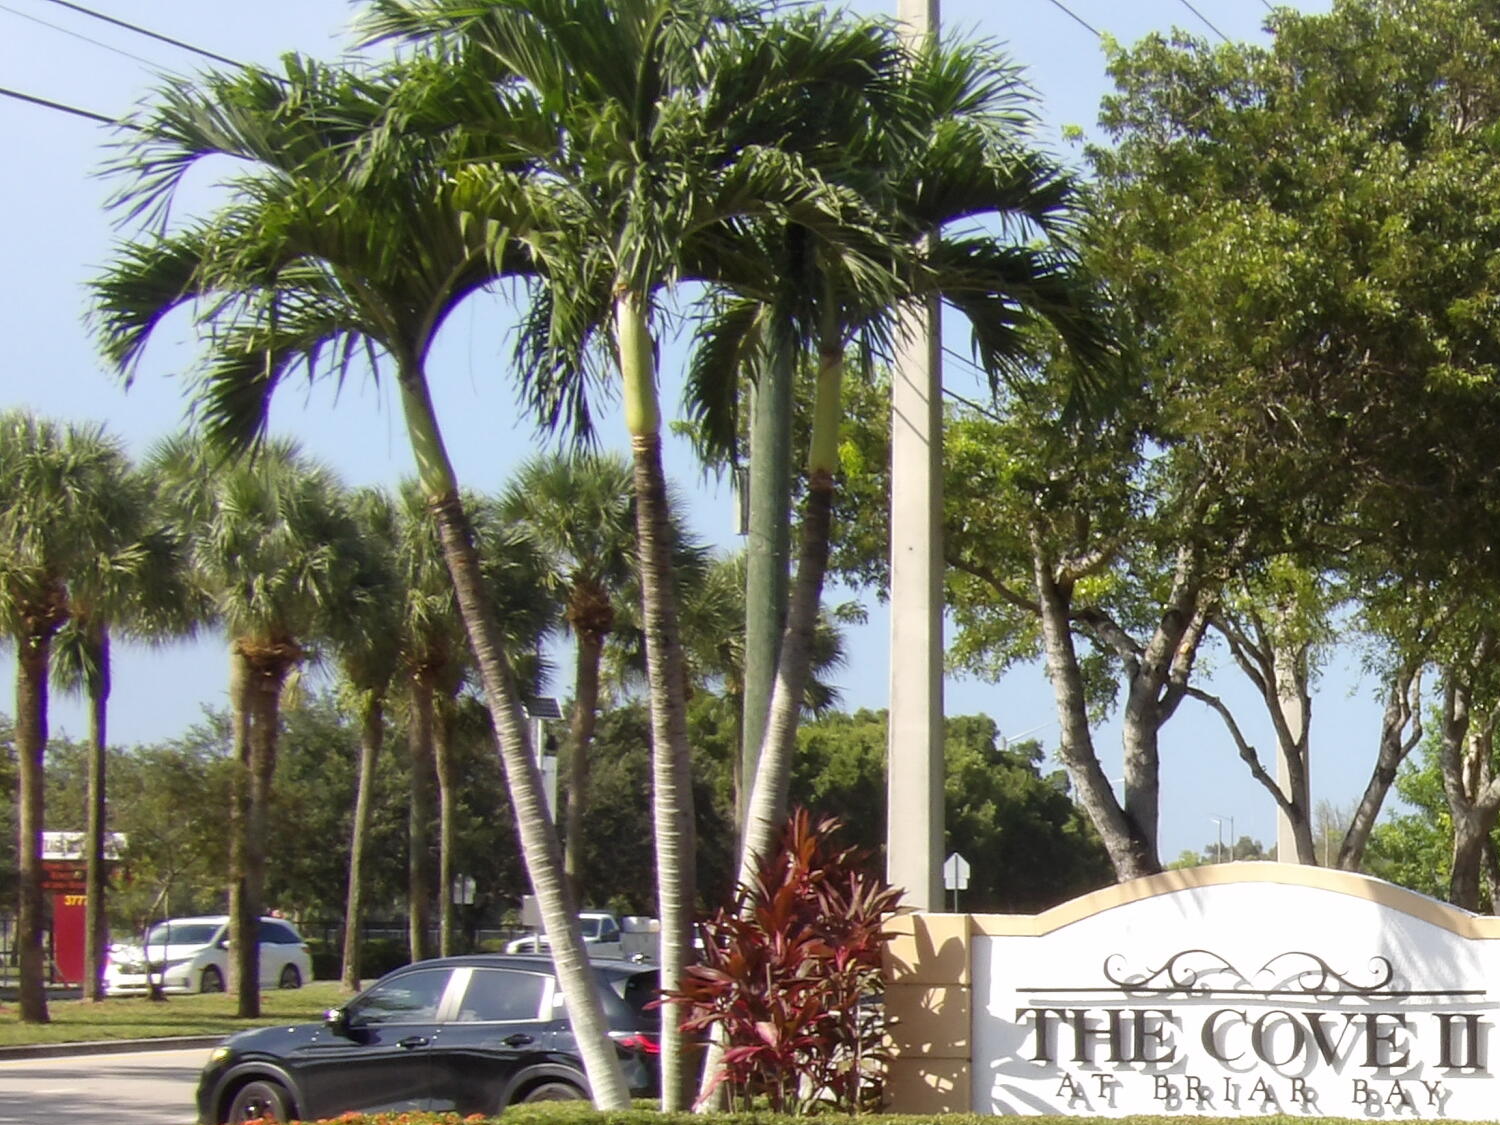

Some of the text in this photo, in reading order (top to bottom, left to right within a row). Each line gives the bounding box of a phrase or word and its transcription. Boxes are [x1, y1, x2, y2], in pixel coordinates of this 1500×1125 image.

[1016, 1008, 1486, 1069] THE COVE II
[1056, 1072, 1442, 1106] AT BRIAR BAY
